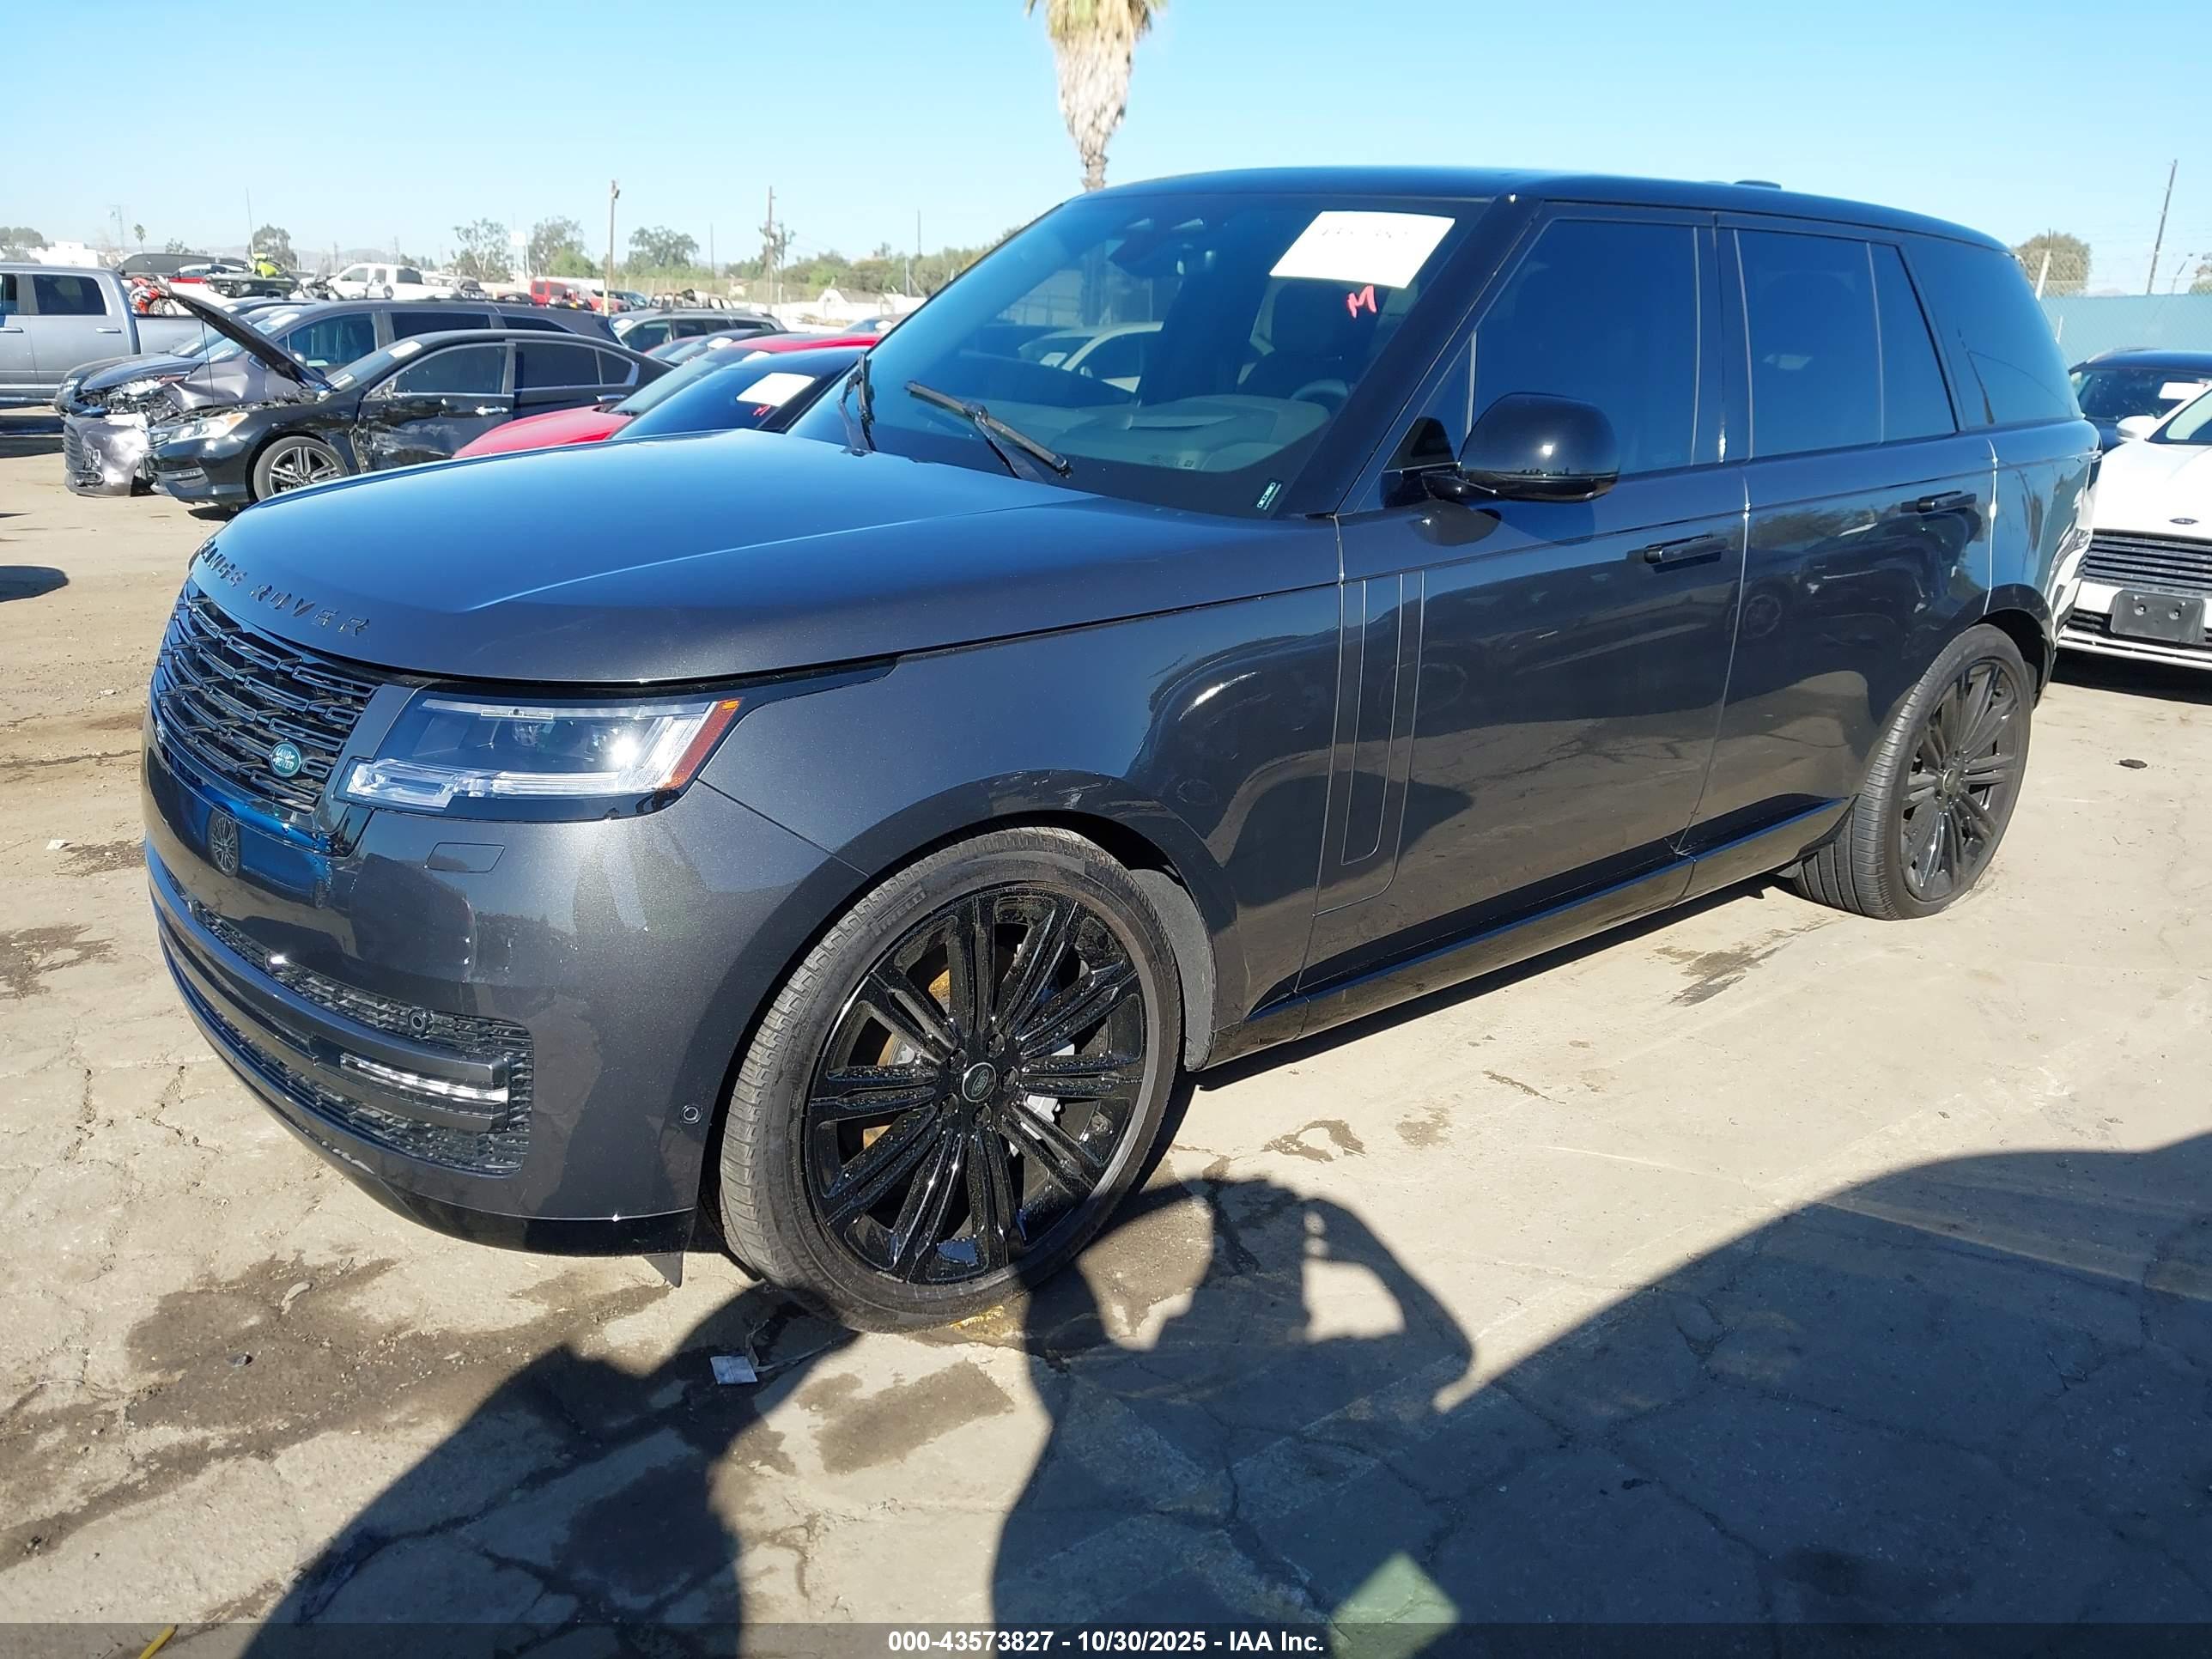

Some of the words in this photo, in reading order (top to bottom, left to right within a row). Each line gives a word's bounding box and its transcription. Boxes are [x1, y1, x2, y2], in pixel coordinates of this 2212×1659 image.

[1346, 283, 1379, 319] M
[199, 538, 248, 587] RANGE
[249, 583, 372, 637] ROVER
[274, 757, 295, 770] ROVER
[276, 747, 292, 760] LAND
